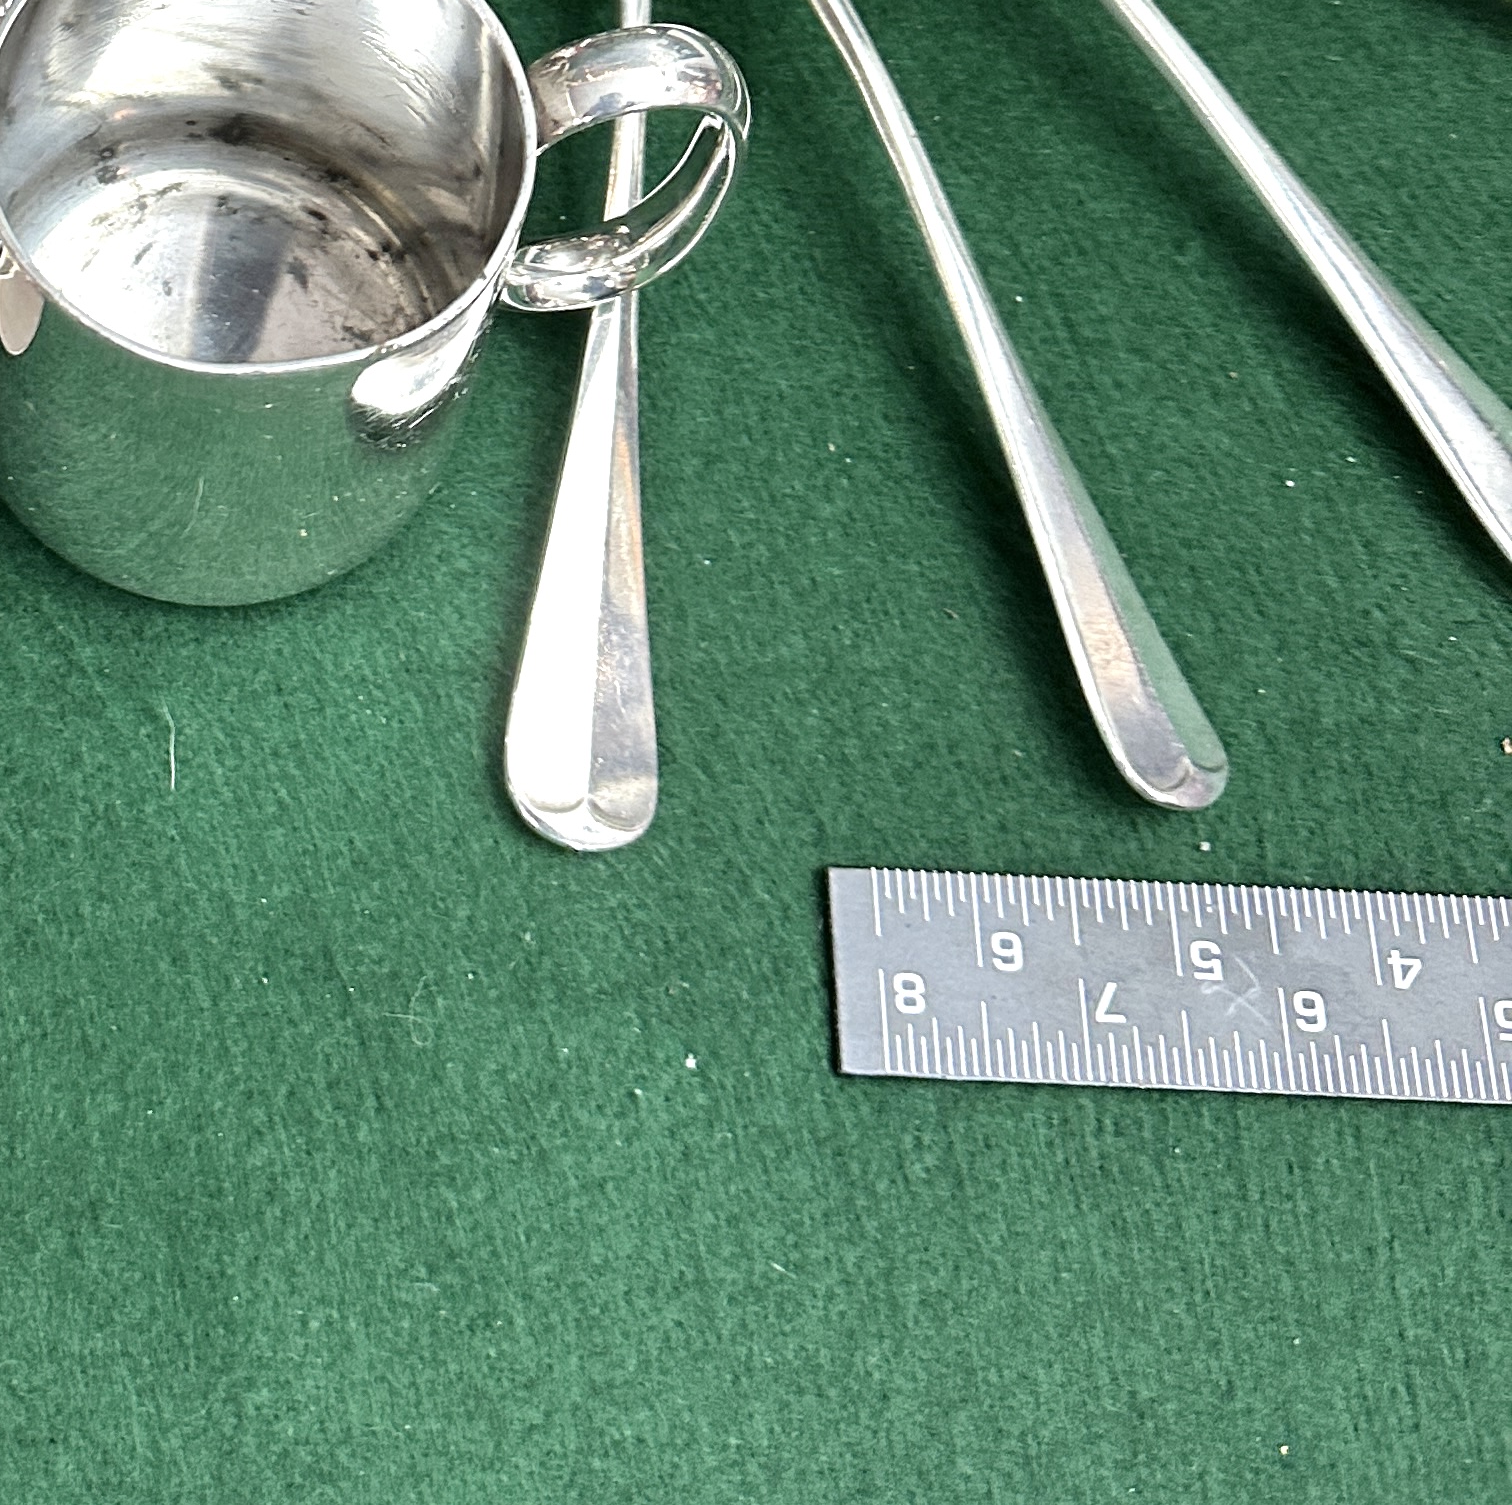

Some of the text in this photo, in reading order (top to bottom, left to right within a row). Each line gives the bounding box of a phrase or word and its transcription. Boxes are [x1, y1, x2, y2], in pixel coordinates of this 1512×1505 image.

[991, 931, 1422, 990] 4 5 6
[893, 972, 926, 1015] 8
[1095, 981, 1127, 1024] 7
[1293, 990, 1327, 1033] 6
